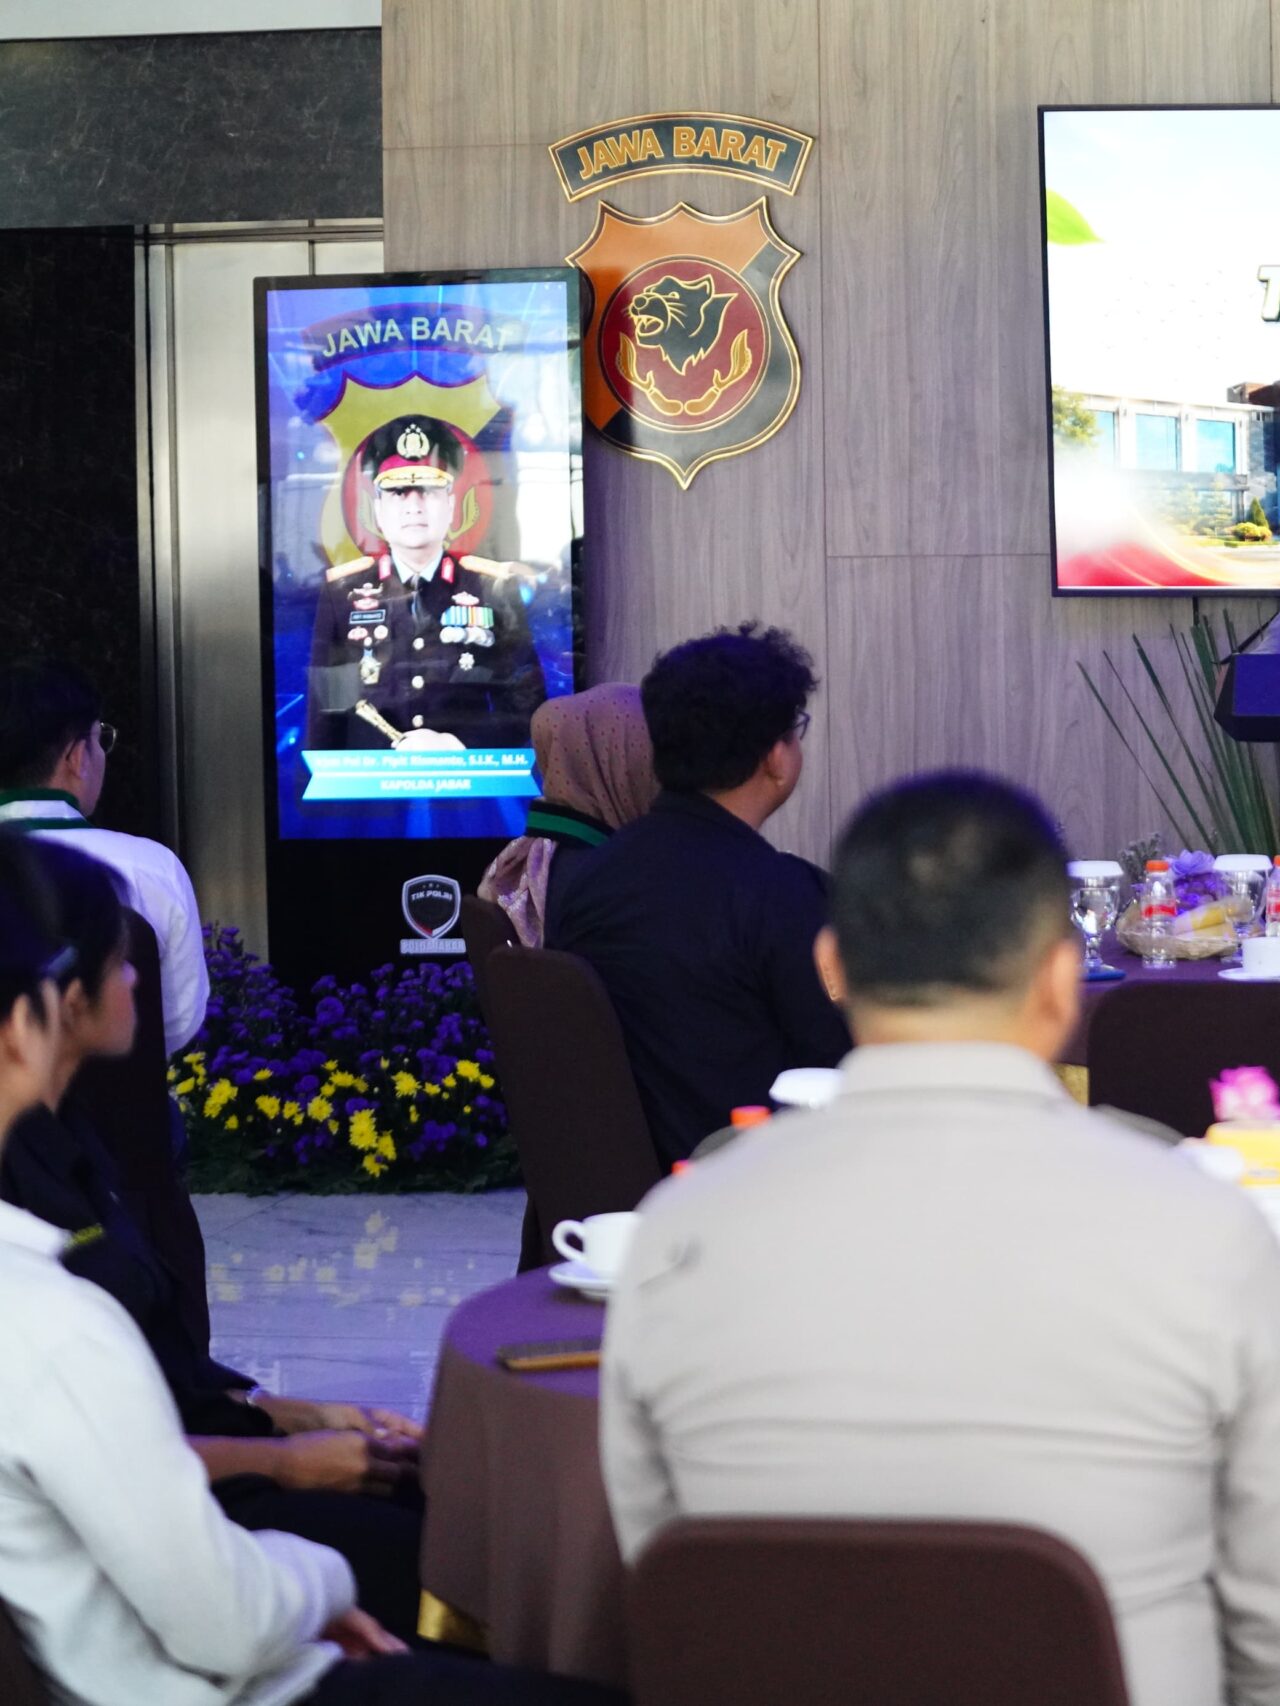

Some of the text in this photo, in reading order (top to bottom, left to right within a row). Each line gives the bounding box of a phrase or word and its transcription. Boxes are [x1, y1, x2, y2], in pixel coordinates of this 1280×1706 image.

[577, 126, 787, 179] JAWA BARAT
[322, 316, 513, 358] JAWA BARAT
[380, 779, 433, 790] KAPOLDA
[411, 889, 453, 901] TIK POLRI
